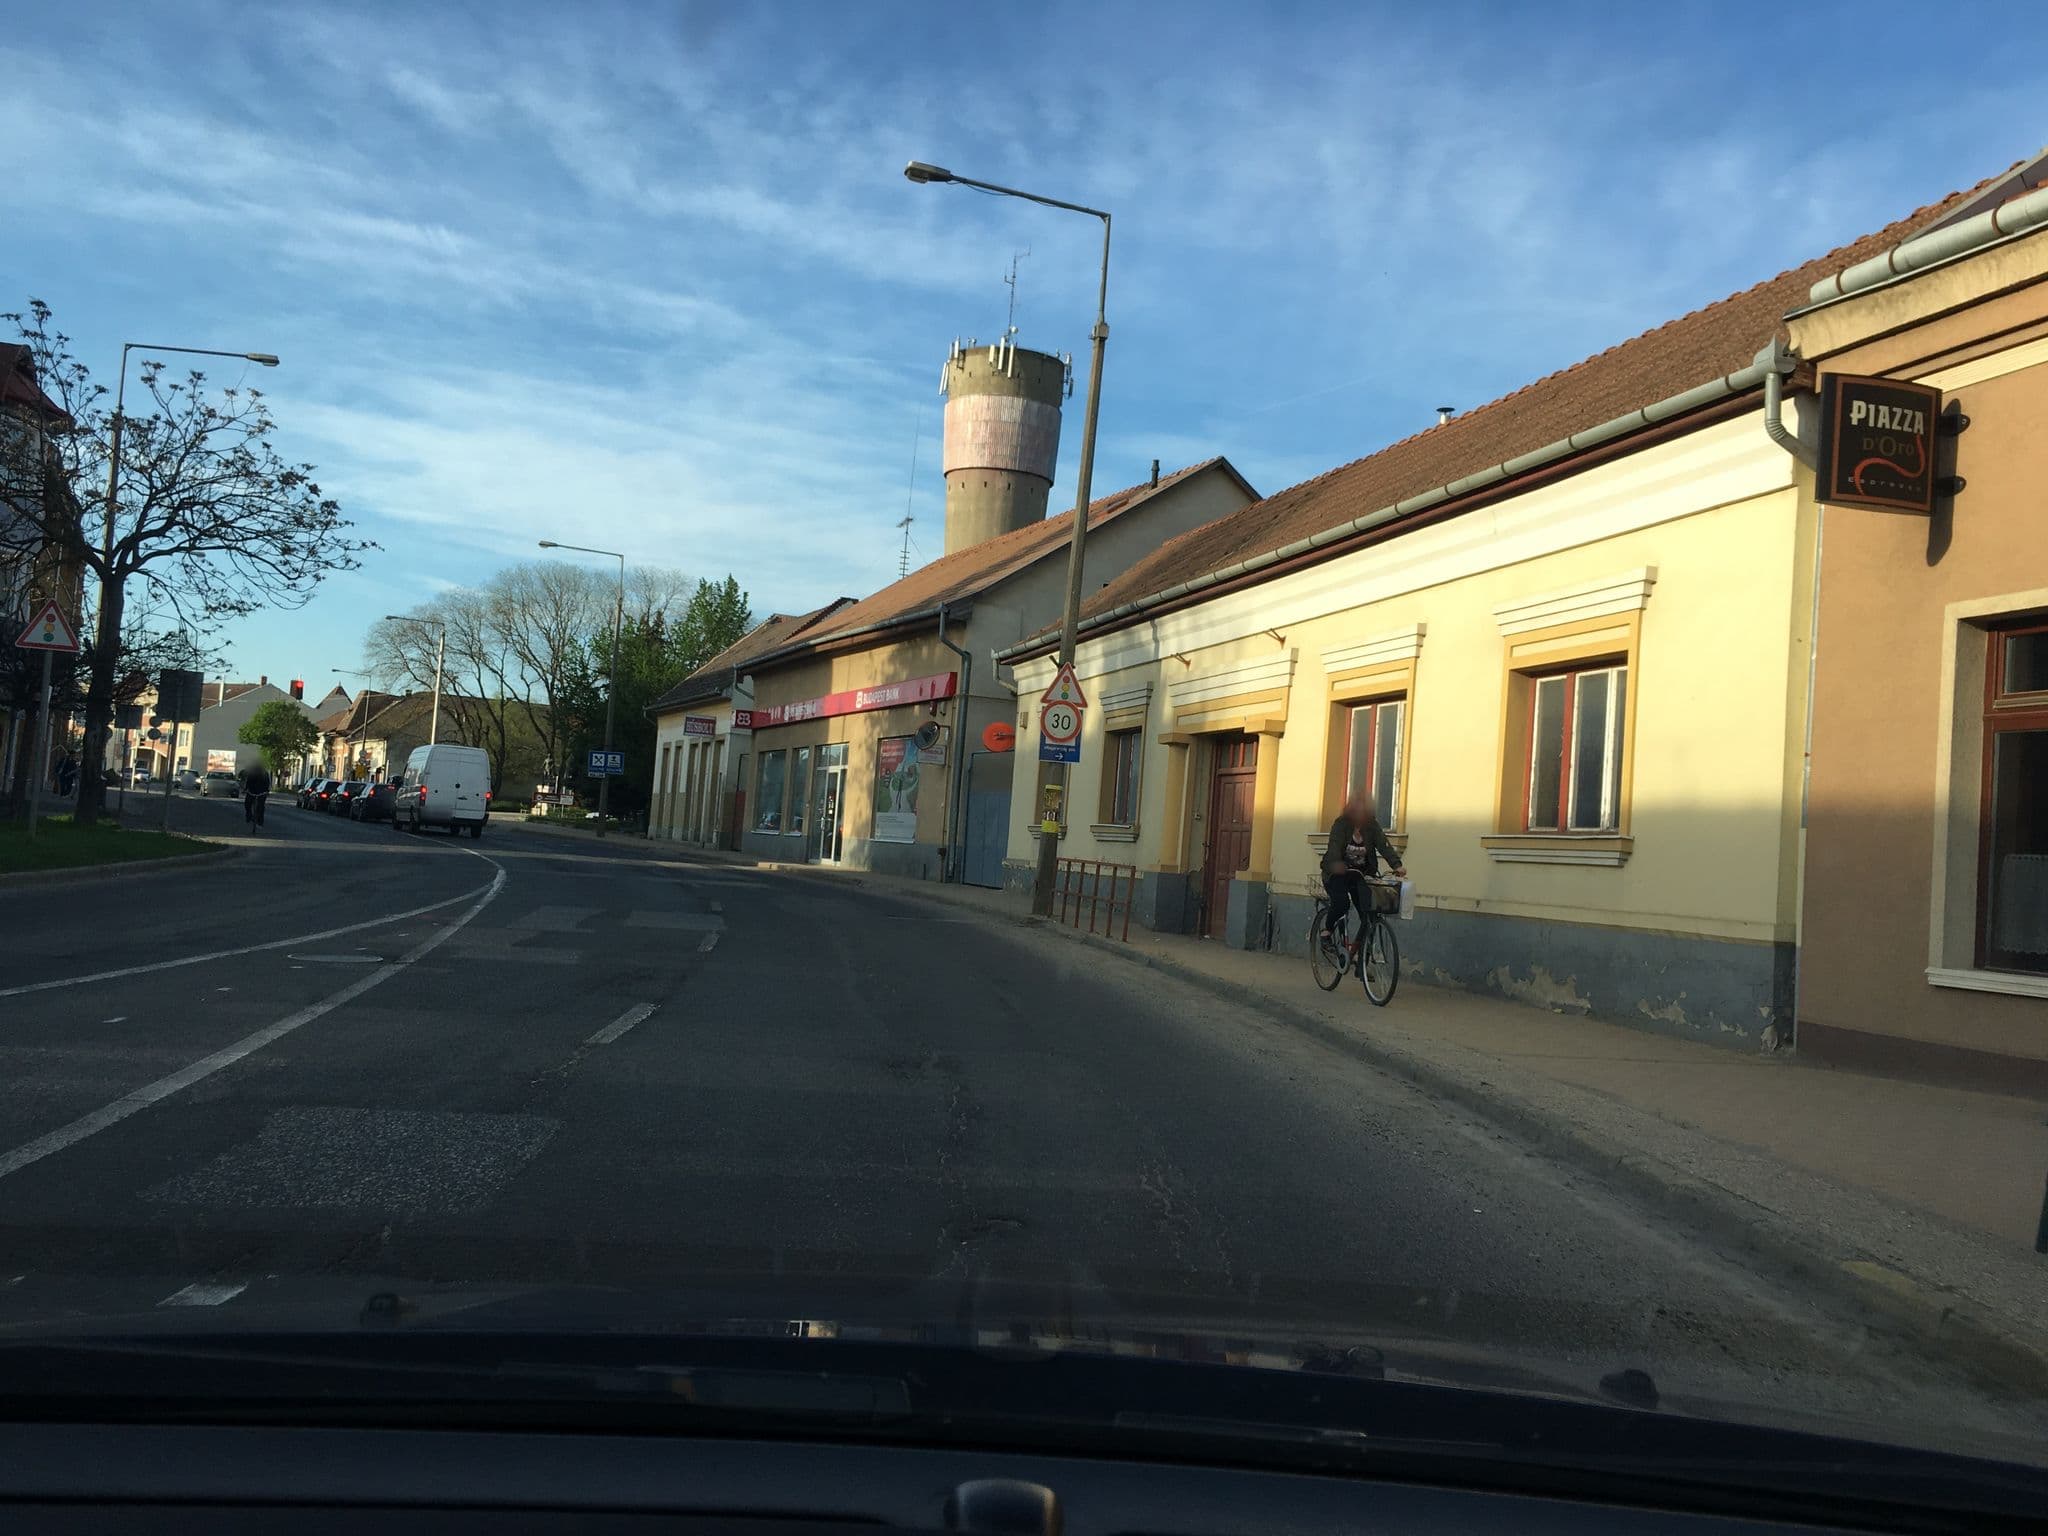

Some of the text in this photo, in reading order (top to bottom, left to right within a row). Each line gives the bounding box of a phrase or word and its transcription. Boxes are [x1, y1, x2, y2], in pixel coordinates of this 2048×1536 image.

[1849, 400, 1924, 435] PIAZZA
[863, 687, 900, 705] BUDAPEST BANK
[1051, 713, 1071, 730] 30
